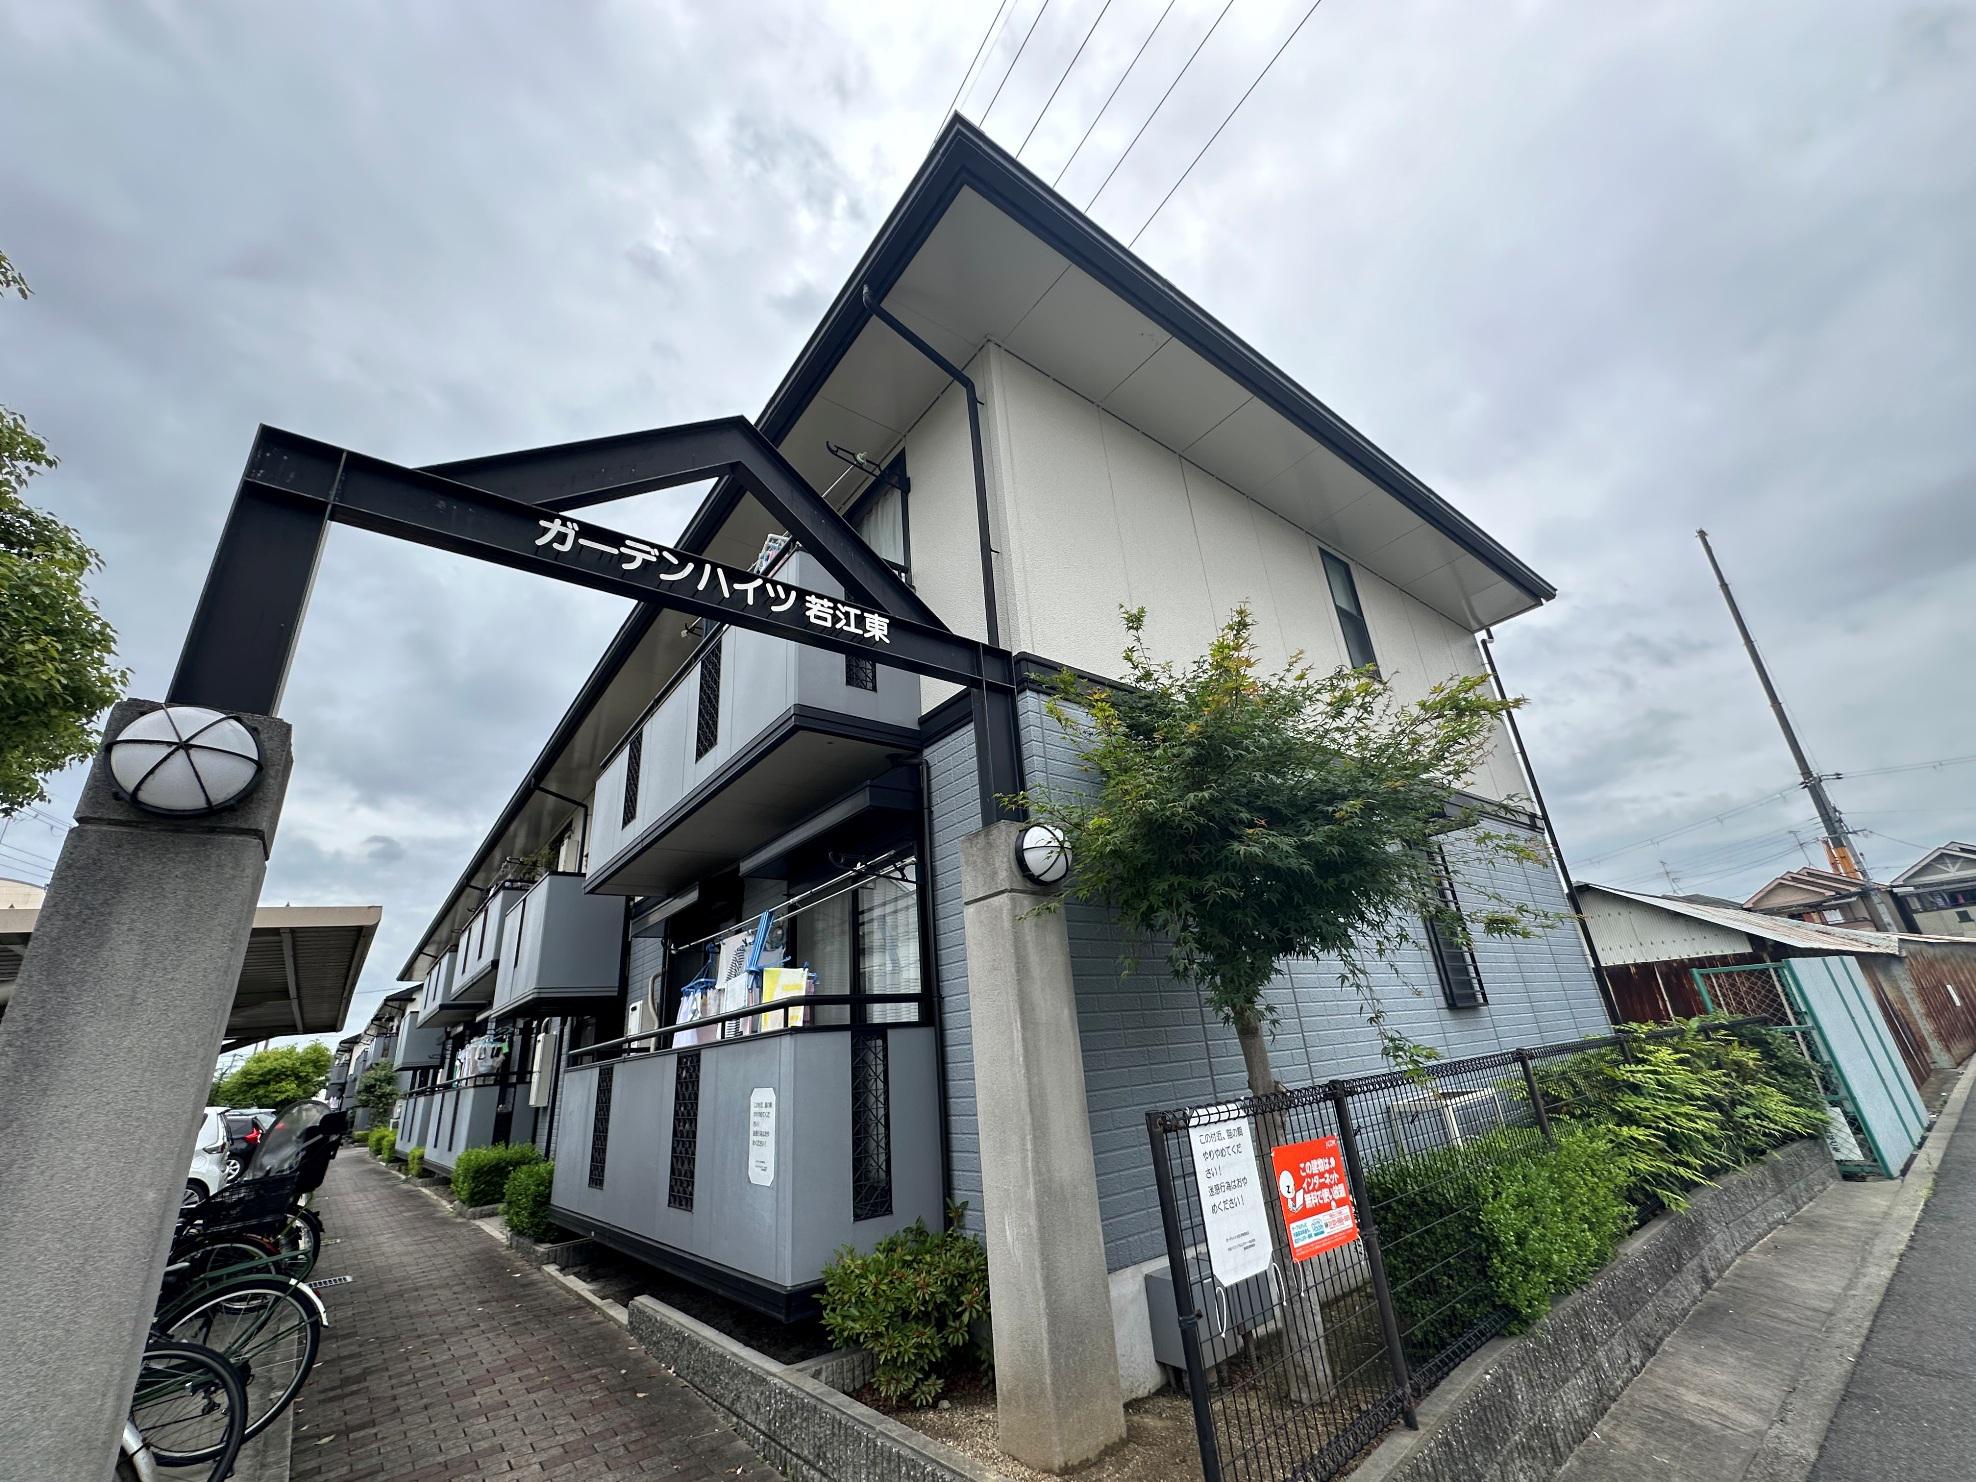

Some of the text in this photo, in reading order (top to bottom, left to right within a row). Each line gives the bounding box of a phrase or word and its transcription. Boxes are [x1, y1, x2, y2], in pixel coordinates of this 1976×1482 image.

[1202, 1143, 1242, 1161] やりやめてくだ
[1302, 1169, 1340, 1192] インターネット
